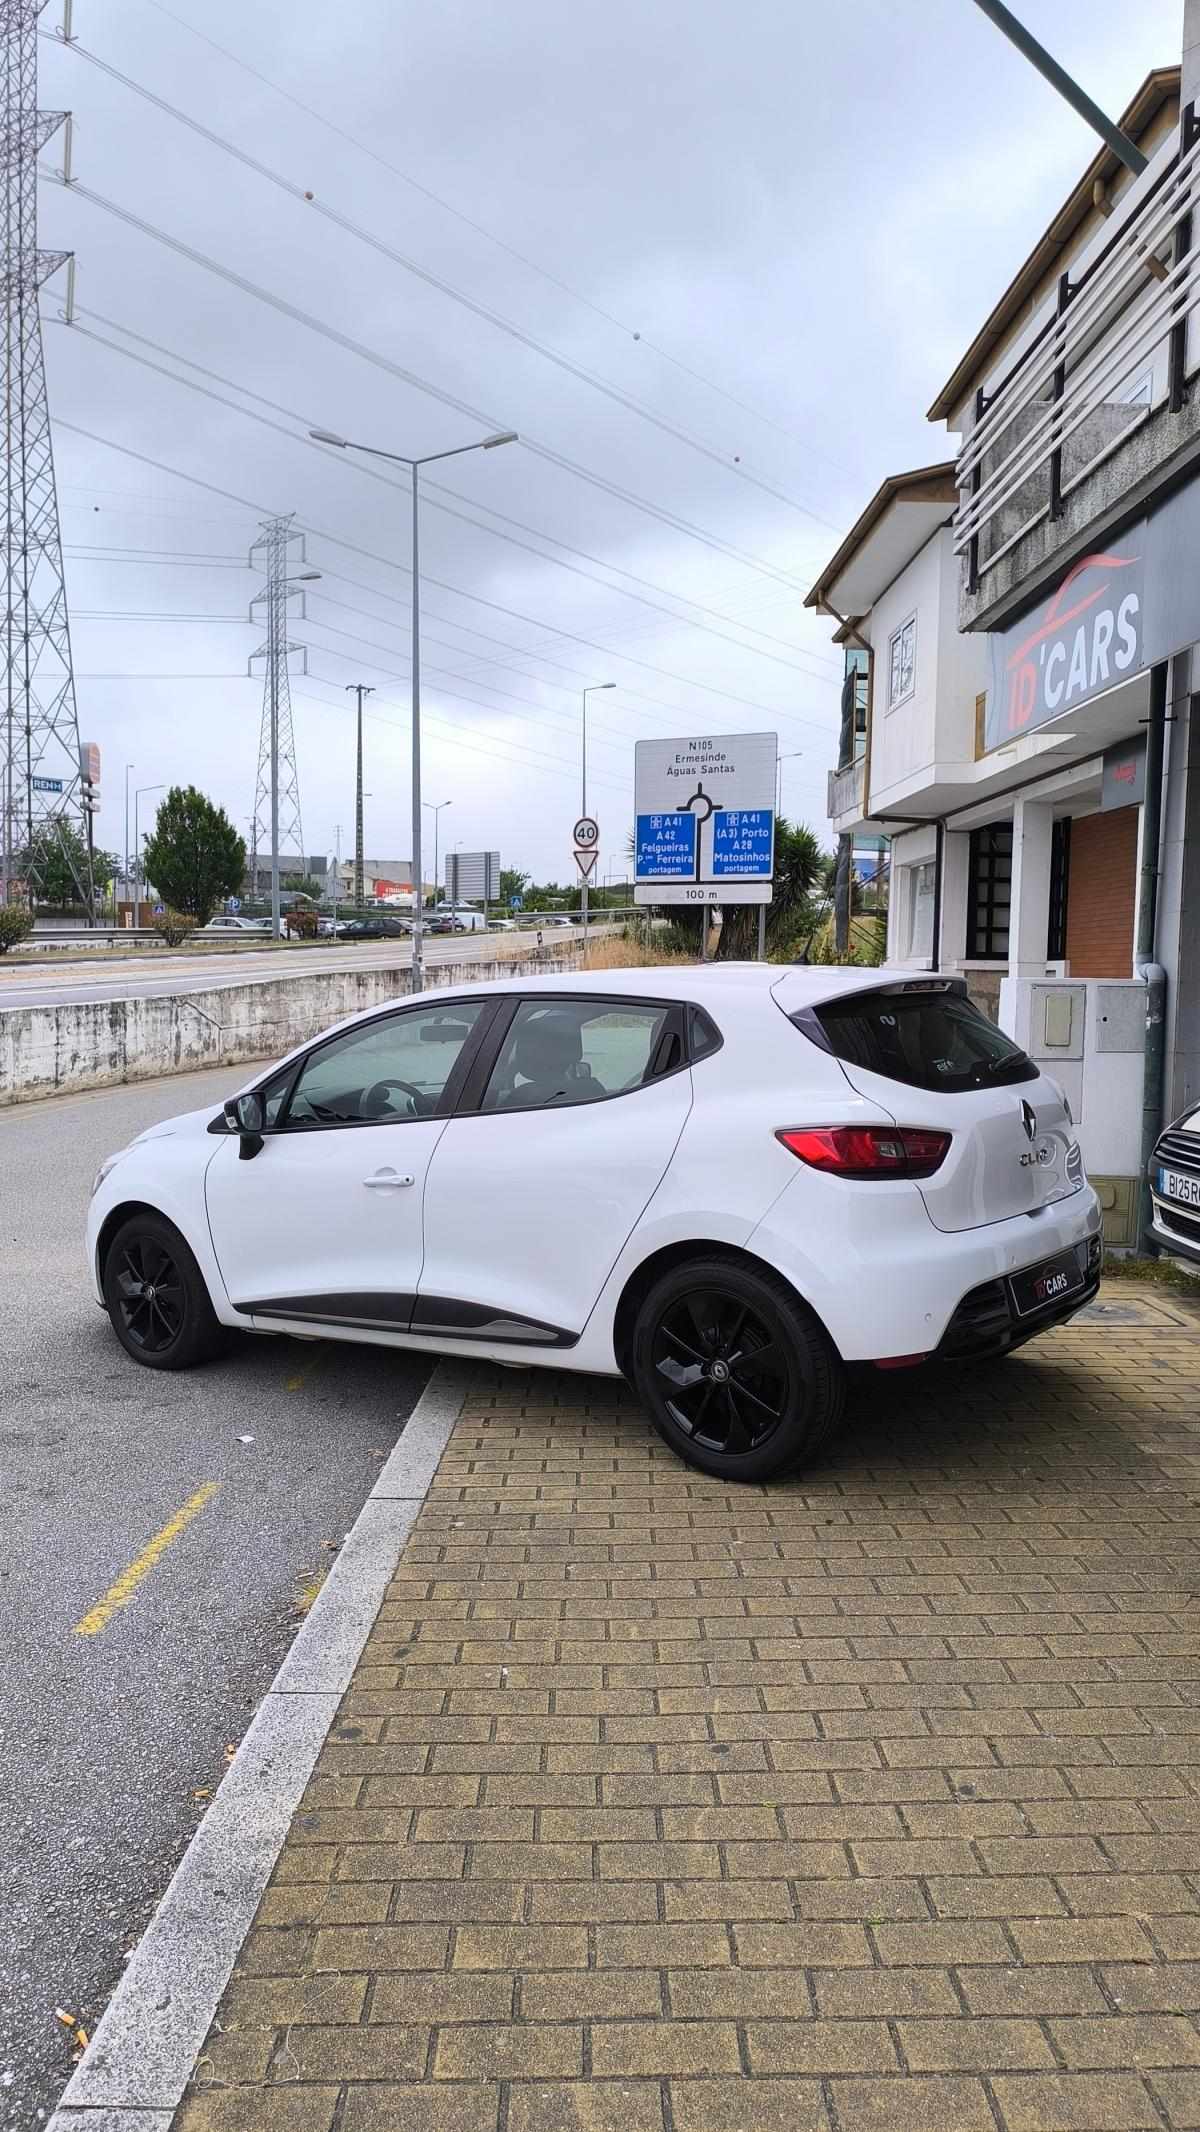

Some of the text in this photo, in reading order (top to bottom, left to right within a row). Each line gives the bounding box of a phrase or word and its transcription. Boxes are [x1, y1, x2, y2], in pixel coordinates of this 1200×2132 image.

[675, 752, 727, 764] Ermesinde
[700, 764, 735, 775] Santas
[577, 827, 595, 839] 40
[742, 828, 769, 838] Porto
[641, 843, 689, 854] Felgueiras
[657, 854, 694, 864] Ferreira
[714, 852, 770, 862] Matosinhos
[648, 865, 682, 874] portagem
[724, 864, 760, 873] portagem
[686, 890, 704, 899] 100
[1169, 1174, 1200, 1204] BI25R
